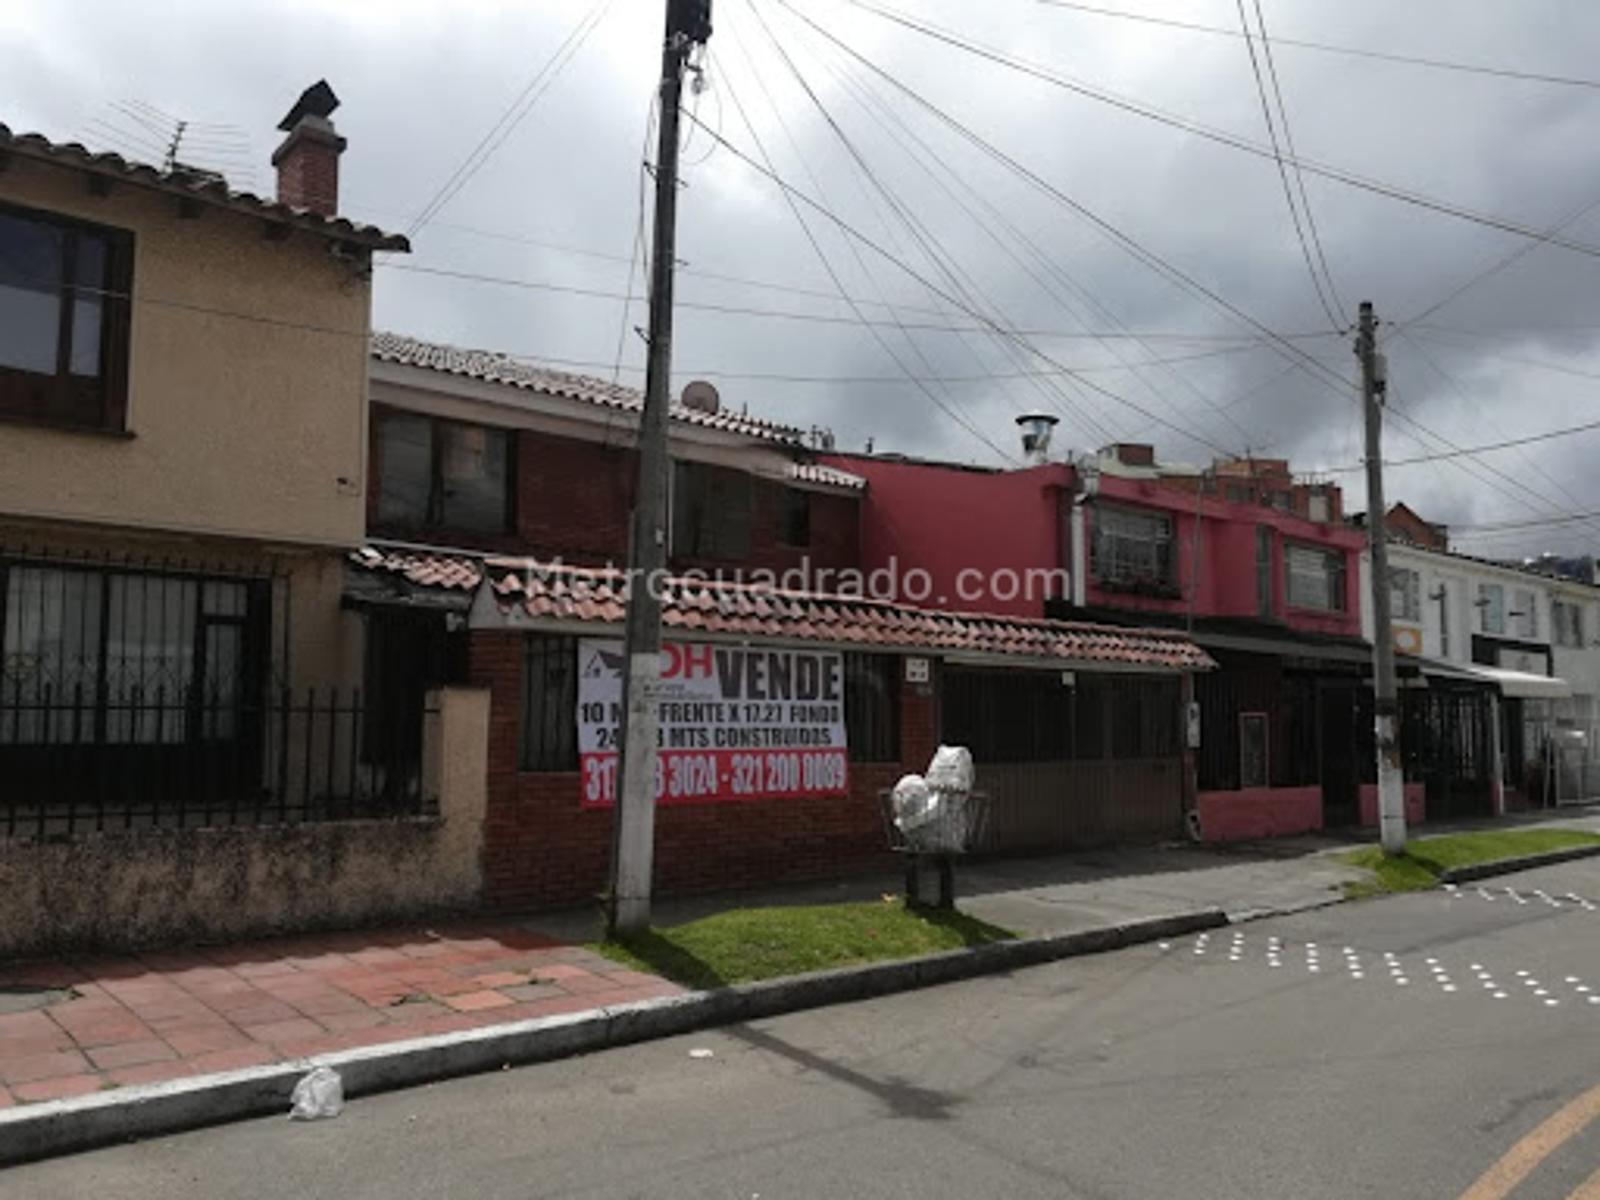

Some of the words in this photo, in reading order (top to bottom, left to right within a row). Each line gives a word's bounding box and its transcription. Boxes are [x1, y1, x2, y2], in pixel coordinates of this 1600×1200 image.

[715, 650, 839, 700] VENDE
[582, 702, 604, 723] 10
[659, 702, 724, 722] FRENTE
[669, 728, 710, 747] MTS
[668, 755, 717, 797] 3024
[731, 753, 763, 794] 321
